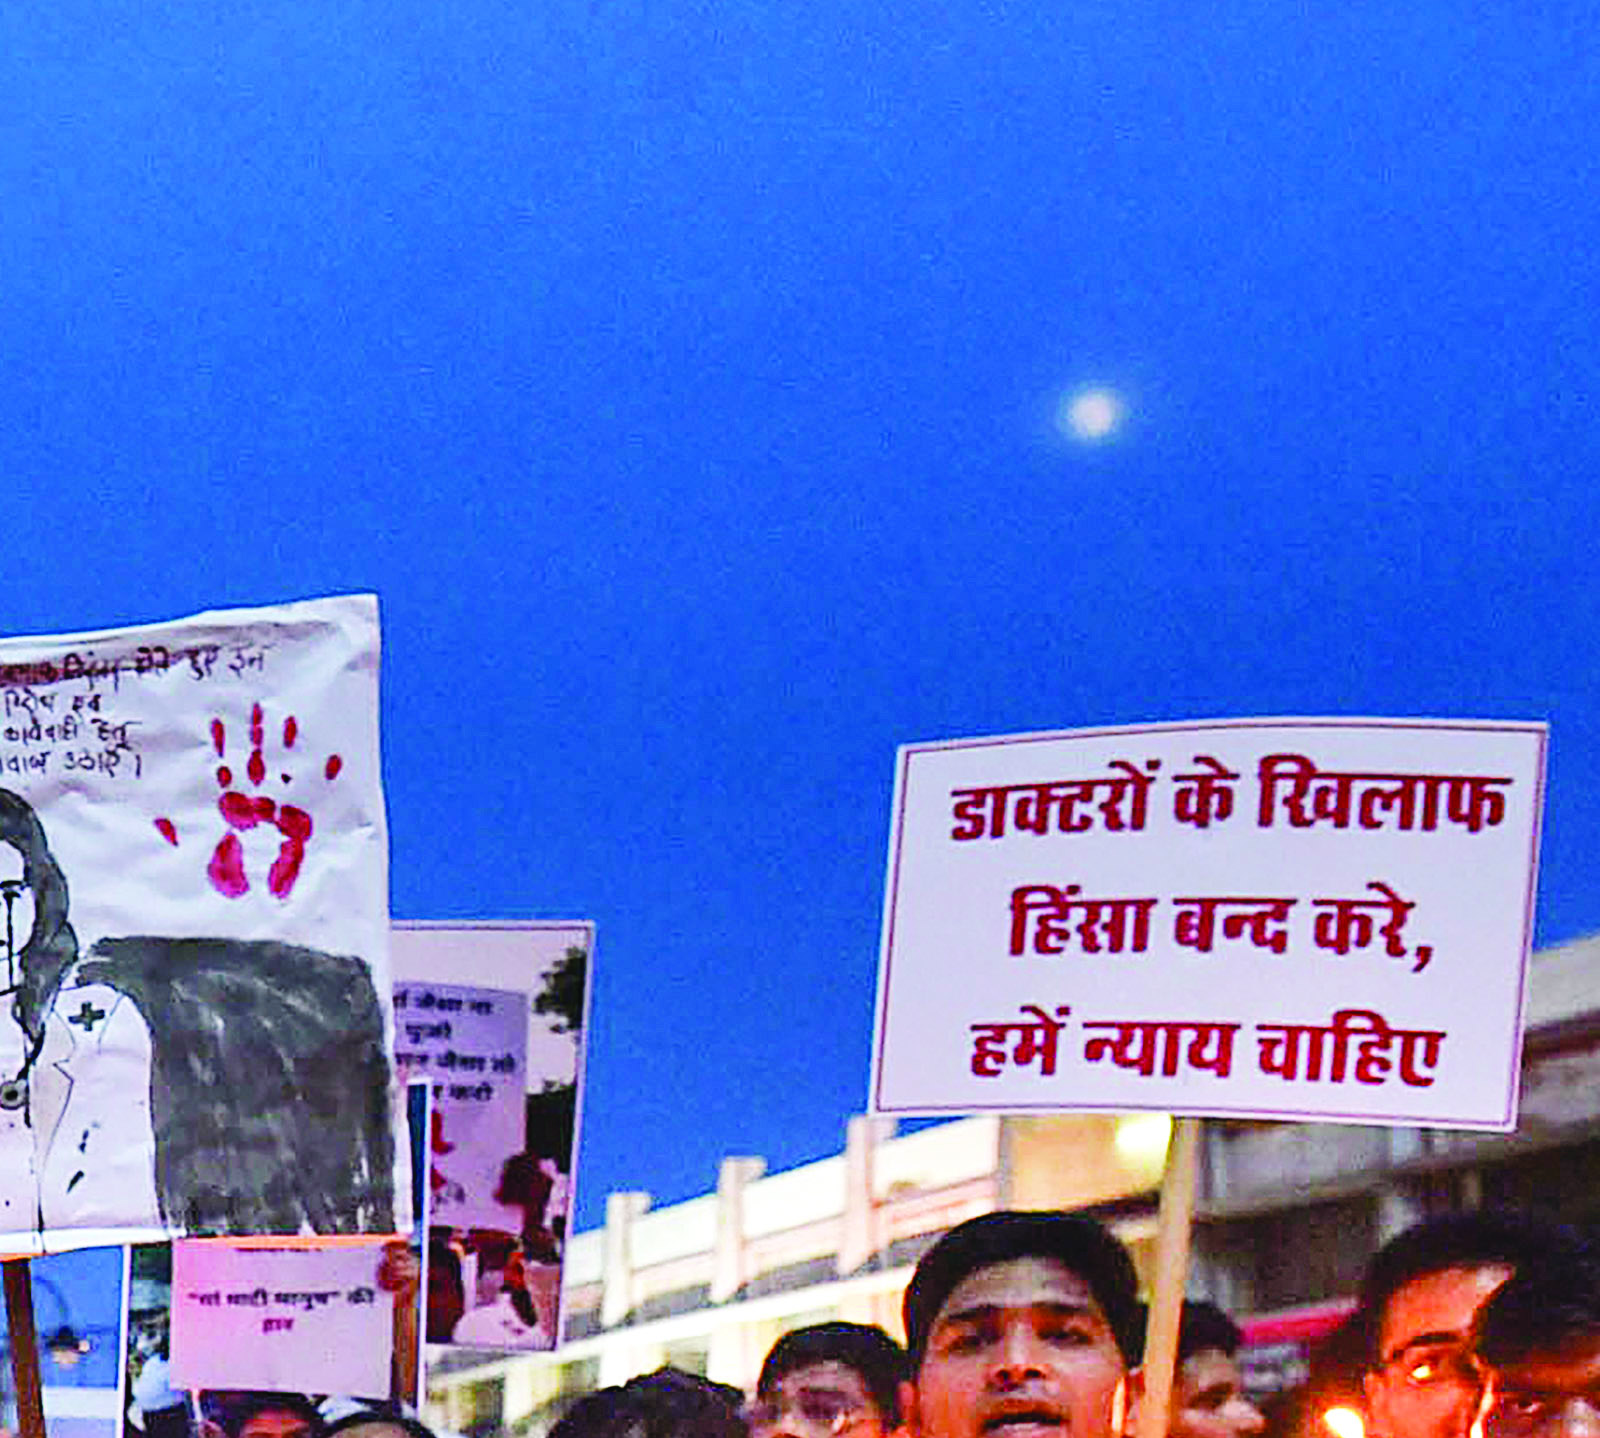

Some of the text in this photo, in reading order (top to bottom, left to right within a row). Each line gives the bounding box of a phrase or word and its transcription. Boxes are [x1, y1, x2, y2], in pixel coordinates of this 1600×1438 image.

[950, 754, 1513, 841] डाक्टरों के खिलाफ
[1008, 881, 1433, 972] हिंसा बन्द करे,
[971, 1005, 1447, 1087] हमें न्याय चाहिए
